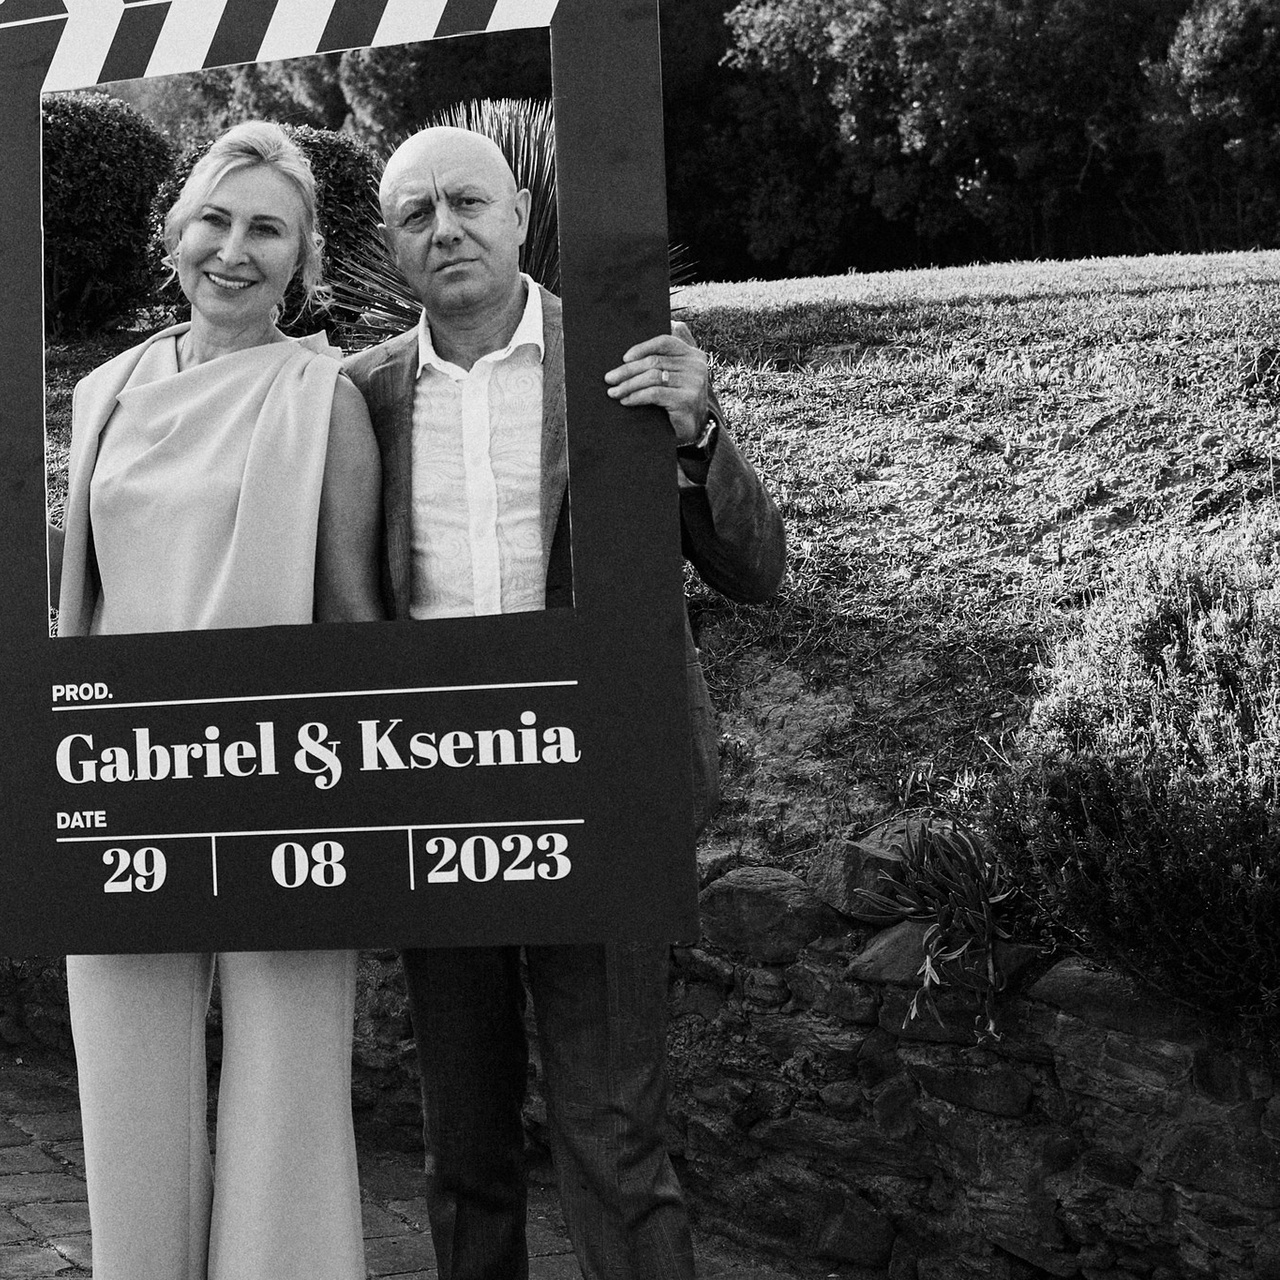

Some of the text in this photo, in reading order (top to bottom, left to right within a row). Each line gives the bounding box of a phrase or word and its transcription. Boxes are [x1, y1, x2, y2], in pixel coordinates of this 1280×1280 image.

[52, 682, 114, 702] PROD.
[55, 710, 582, 790] Gabriel & Ksenia
[56, 810, 108, 829] DATE
[102, 832, 572, 893] 29 08 2023
